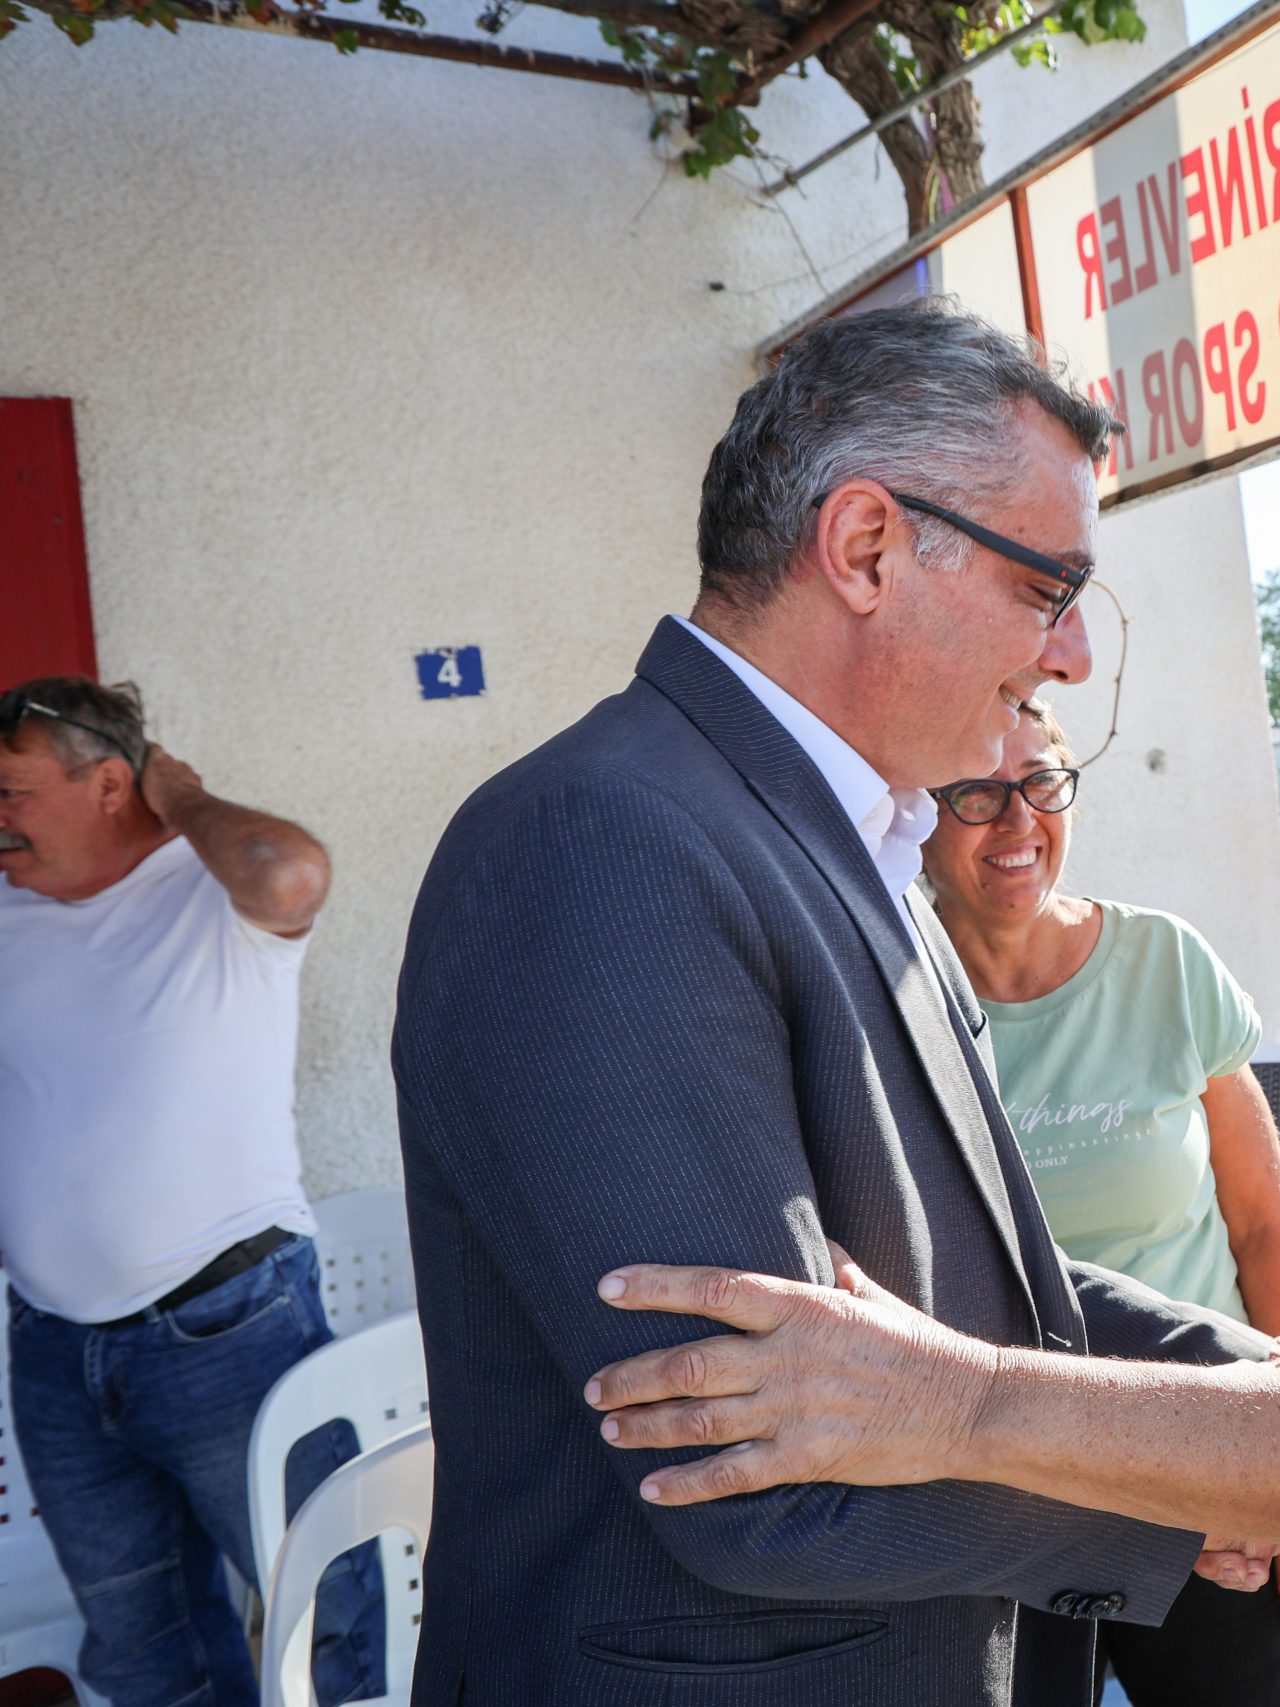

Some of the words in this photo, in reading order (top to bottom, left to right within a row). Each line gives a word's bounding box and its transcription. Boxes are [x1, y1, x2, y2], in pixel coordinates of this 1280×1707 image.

[437, 657, 463, 688] 4
[1012, 1093, 1133, 1134] things
[1034, 1155, 1069, 1169] ONLY
